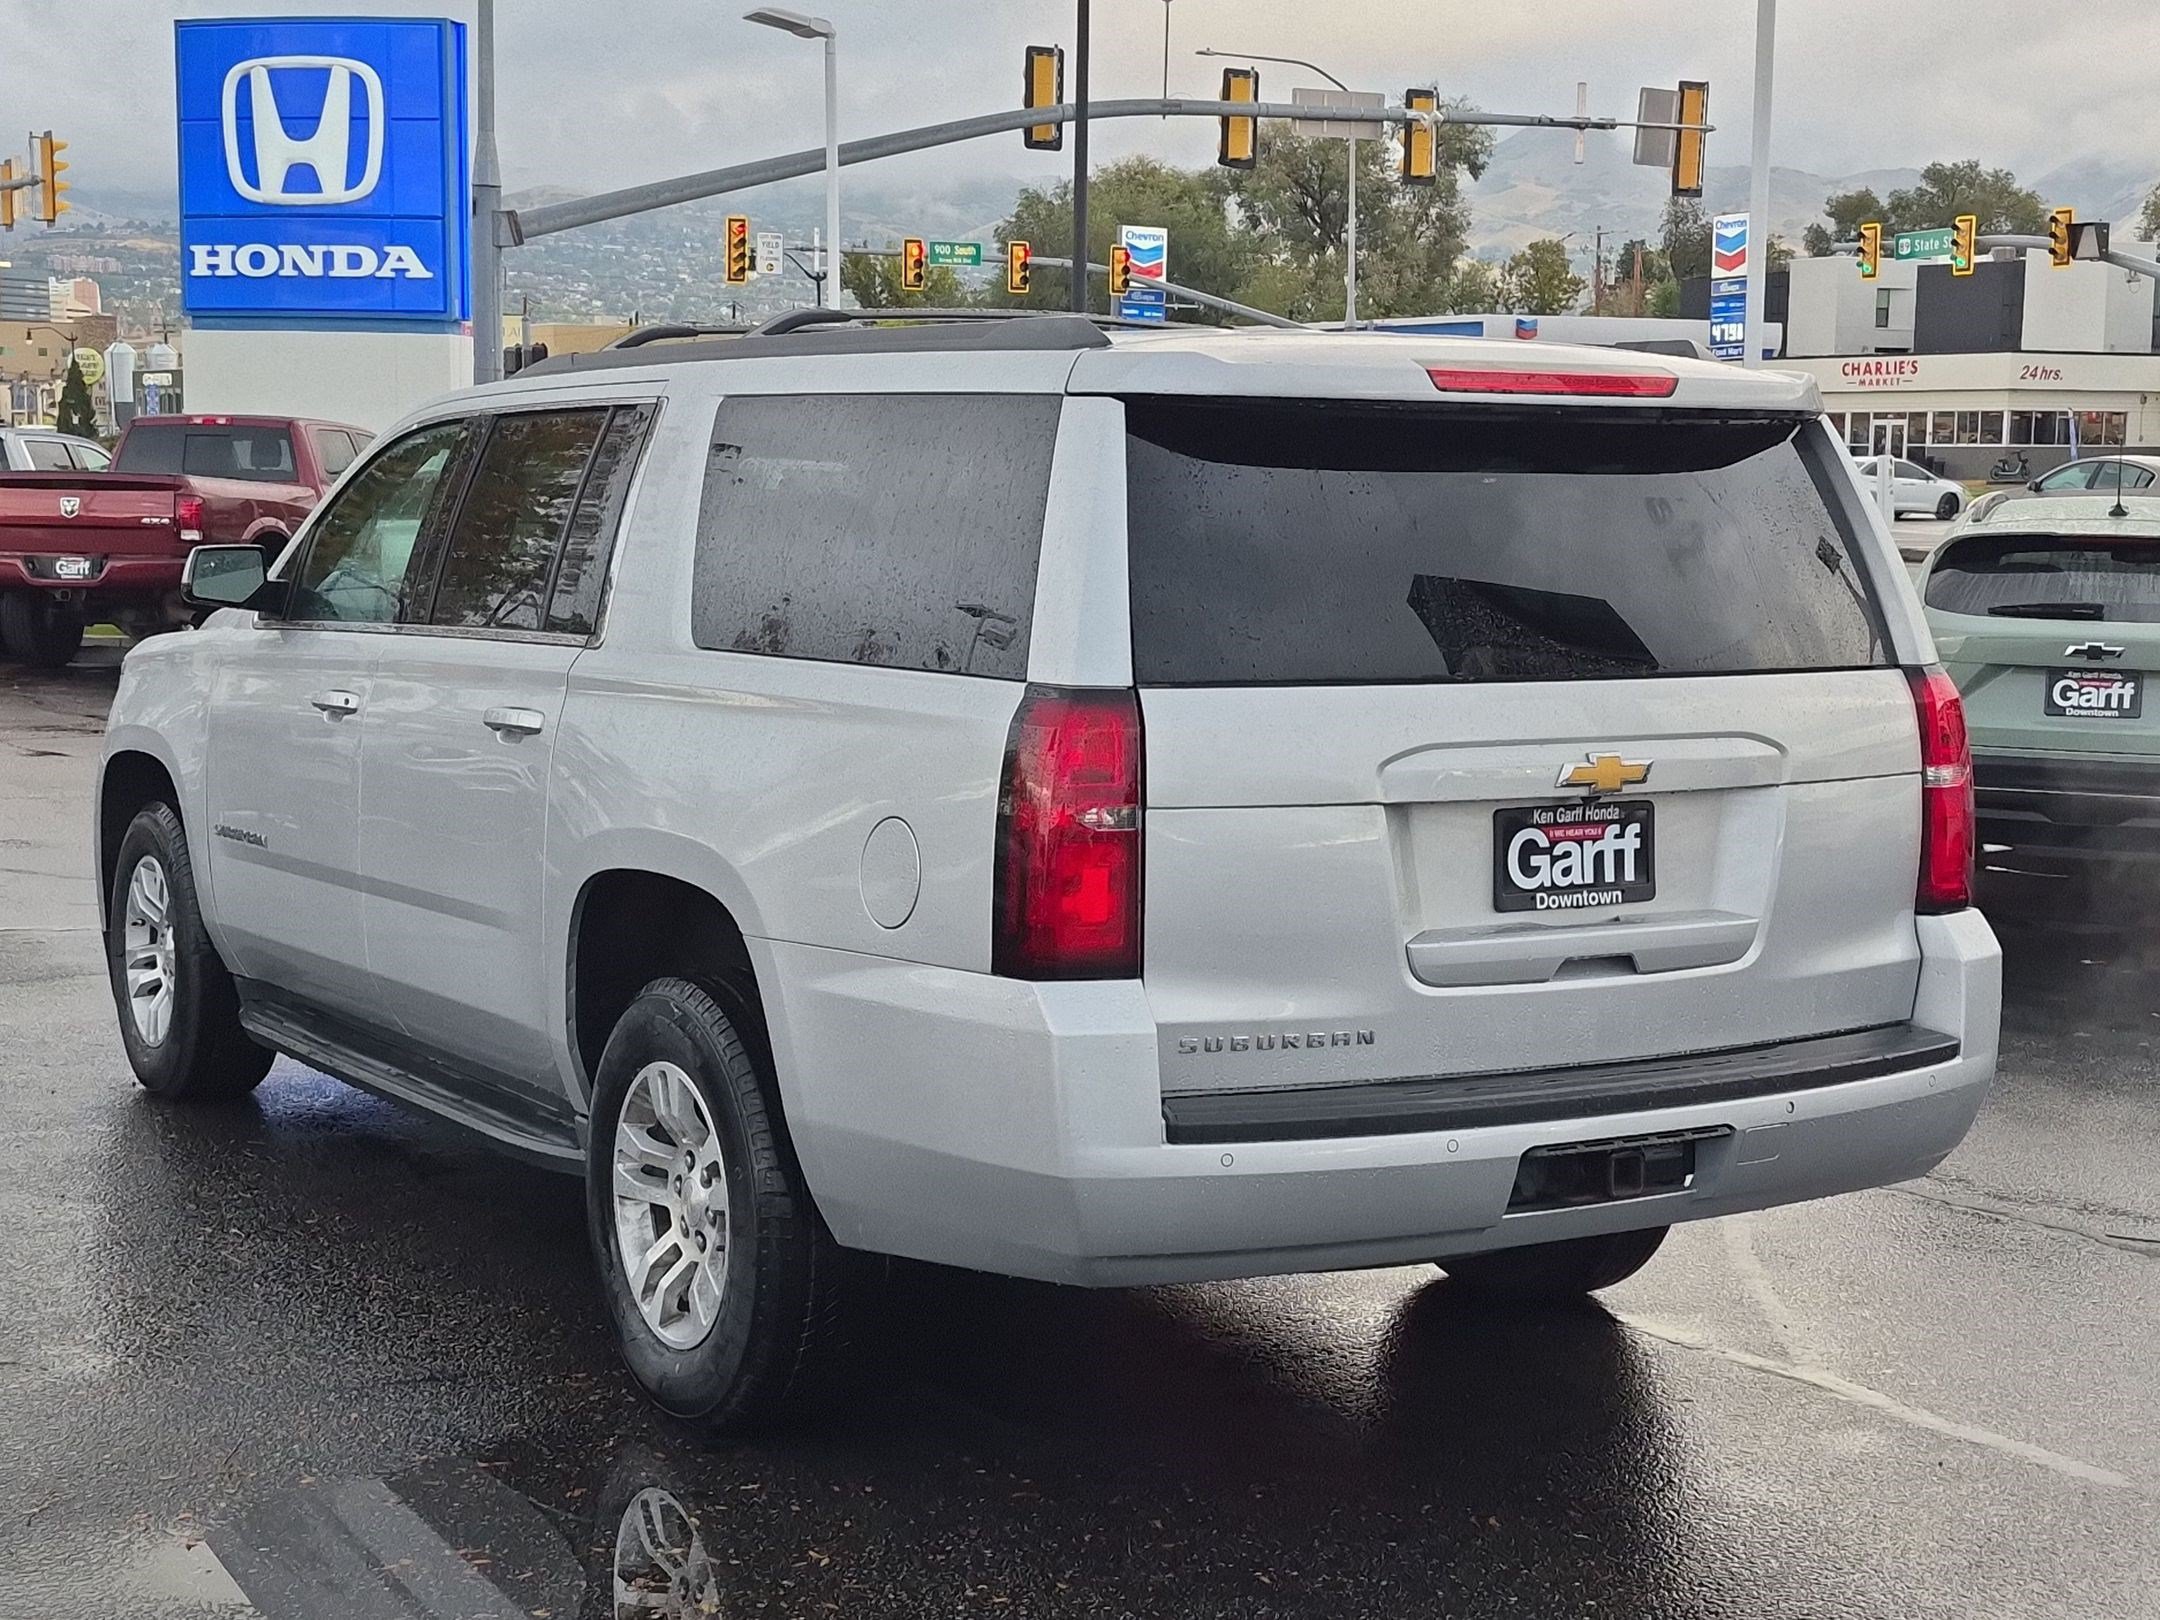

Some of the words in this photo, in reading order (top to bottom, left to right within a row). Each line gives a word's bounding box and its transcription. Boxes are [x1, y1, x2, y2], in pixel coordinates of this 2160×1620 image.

[1716, 220, 1747, 230] Chevron
[1125, 230, 1164, 241] Chevron
[934, 244, 951, 255] 900
[954, 244, 977, 256] South
[1914, 238, 1940, 252] State
[190, 243, 434, 278] HONDA
[1841, 360, 1919, 376] CHARLIE'S
[2019, 365, 2038, 381] 24
[2039, 365, 2064, 381] hrs.
[1858, 377, 1901, 387] MARKET
[55, 560, 91, 575] Garff
[2052, 679, 2135, 709] Garff
[2065, 707, 2119, 717] Downtown
[1533, 808, 1554, 825] Ken
[1556, 805, 1584, 824] Garff
[1585, 804, 1620, 821] Honda
[1554, 829, 1565, 837] WE
[1566, 828, 1583, 836] HEAR
[1584, 828, 1599, 836] YOU
[1507, 822, 1641, 890] Garff
[1535, 890, 1623, 909] Downtown
[1178, 1029, 1375, 1054] SUBURBAN
